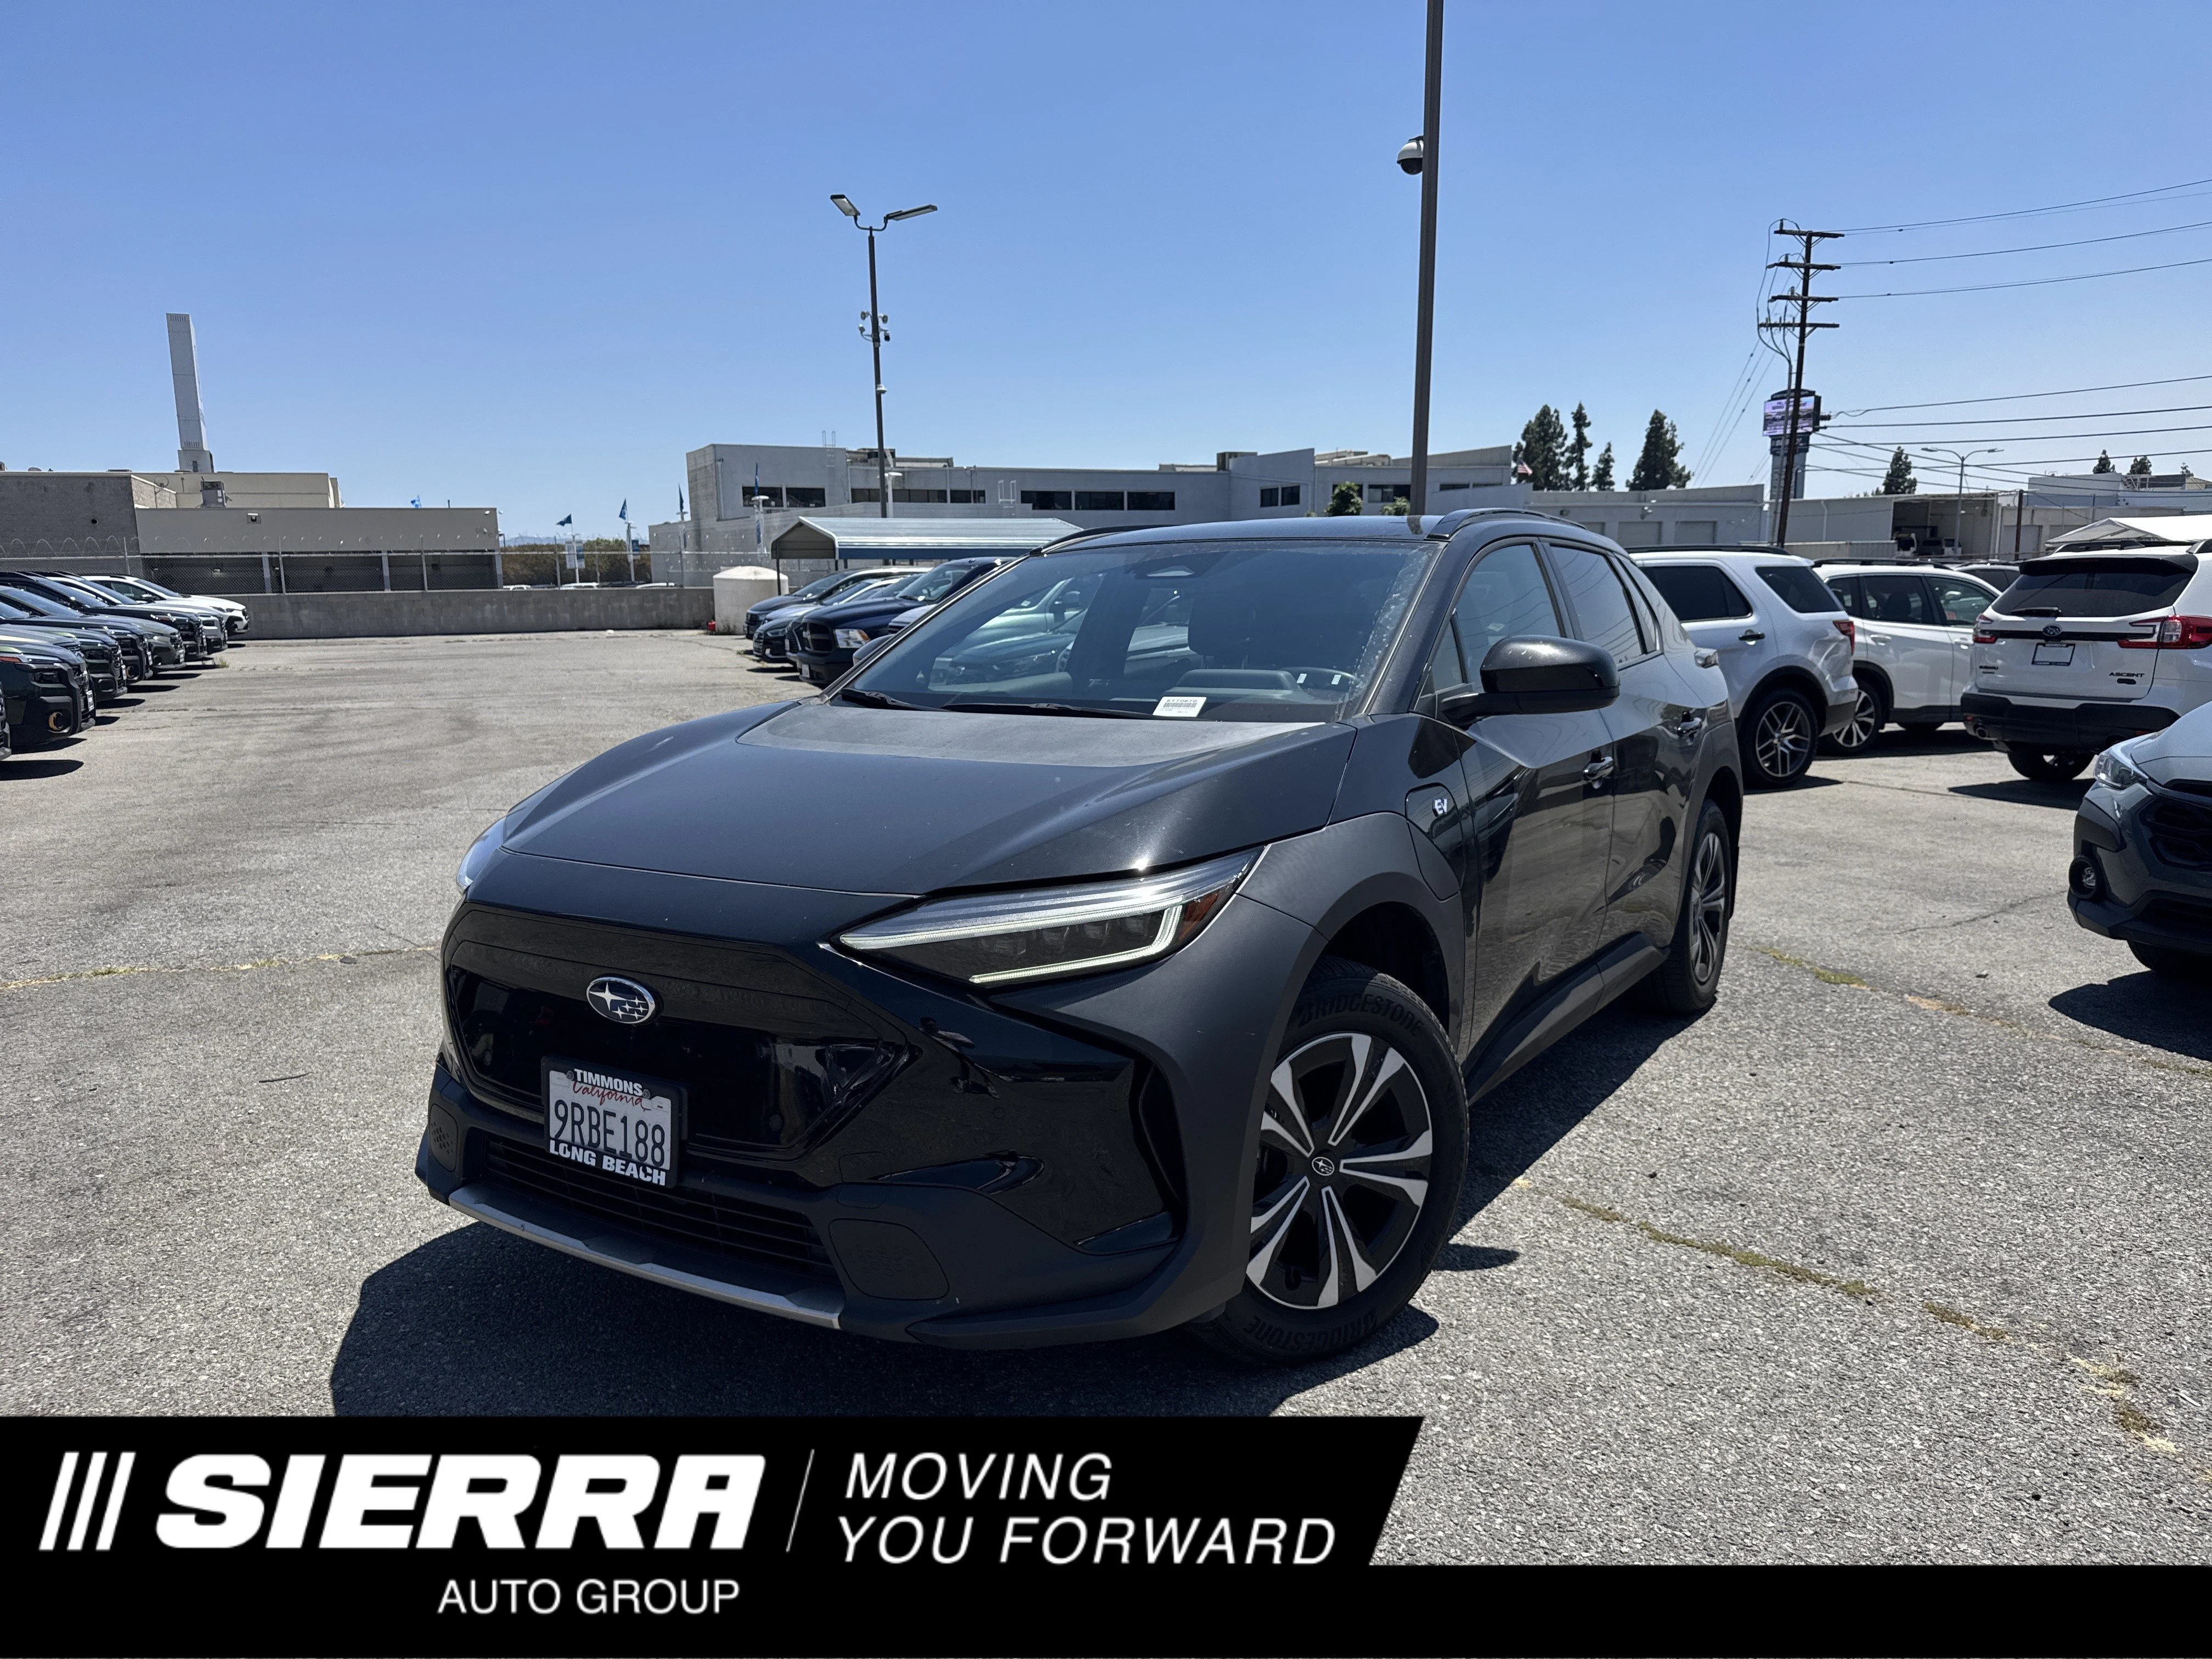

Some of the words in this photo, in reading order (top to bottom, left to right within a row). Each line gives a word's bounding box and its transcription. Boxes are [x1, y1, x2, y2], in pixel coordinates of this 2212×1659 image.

[1434, 798, 1448, 815] EV
[1298, 994, 1425, 1037] BRIDGESTONE
[573, 1081, 651, 1111] California
[574, 1068, 644, 1097] TIMMONS
[554, 1099, 665, 1167] 9RBE188
[549, 1139, 596, 1166] LONG
[602, 1155, 666, 1186] BEACH
[1243, 1308, 1378, 1352] BRIDGESTONE
